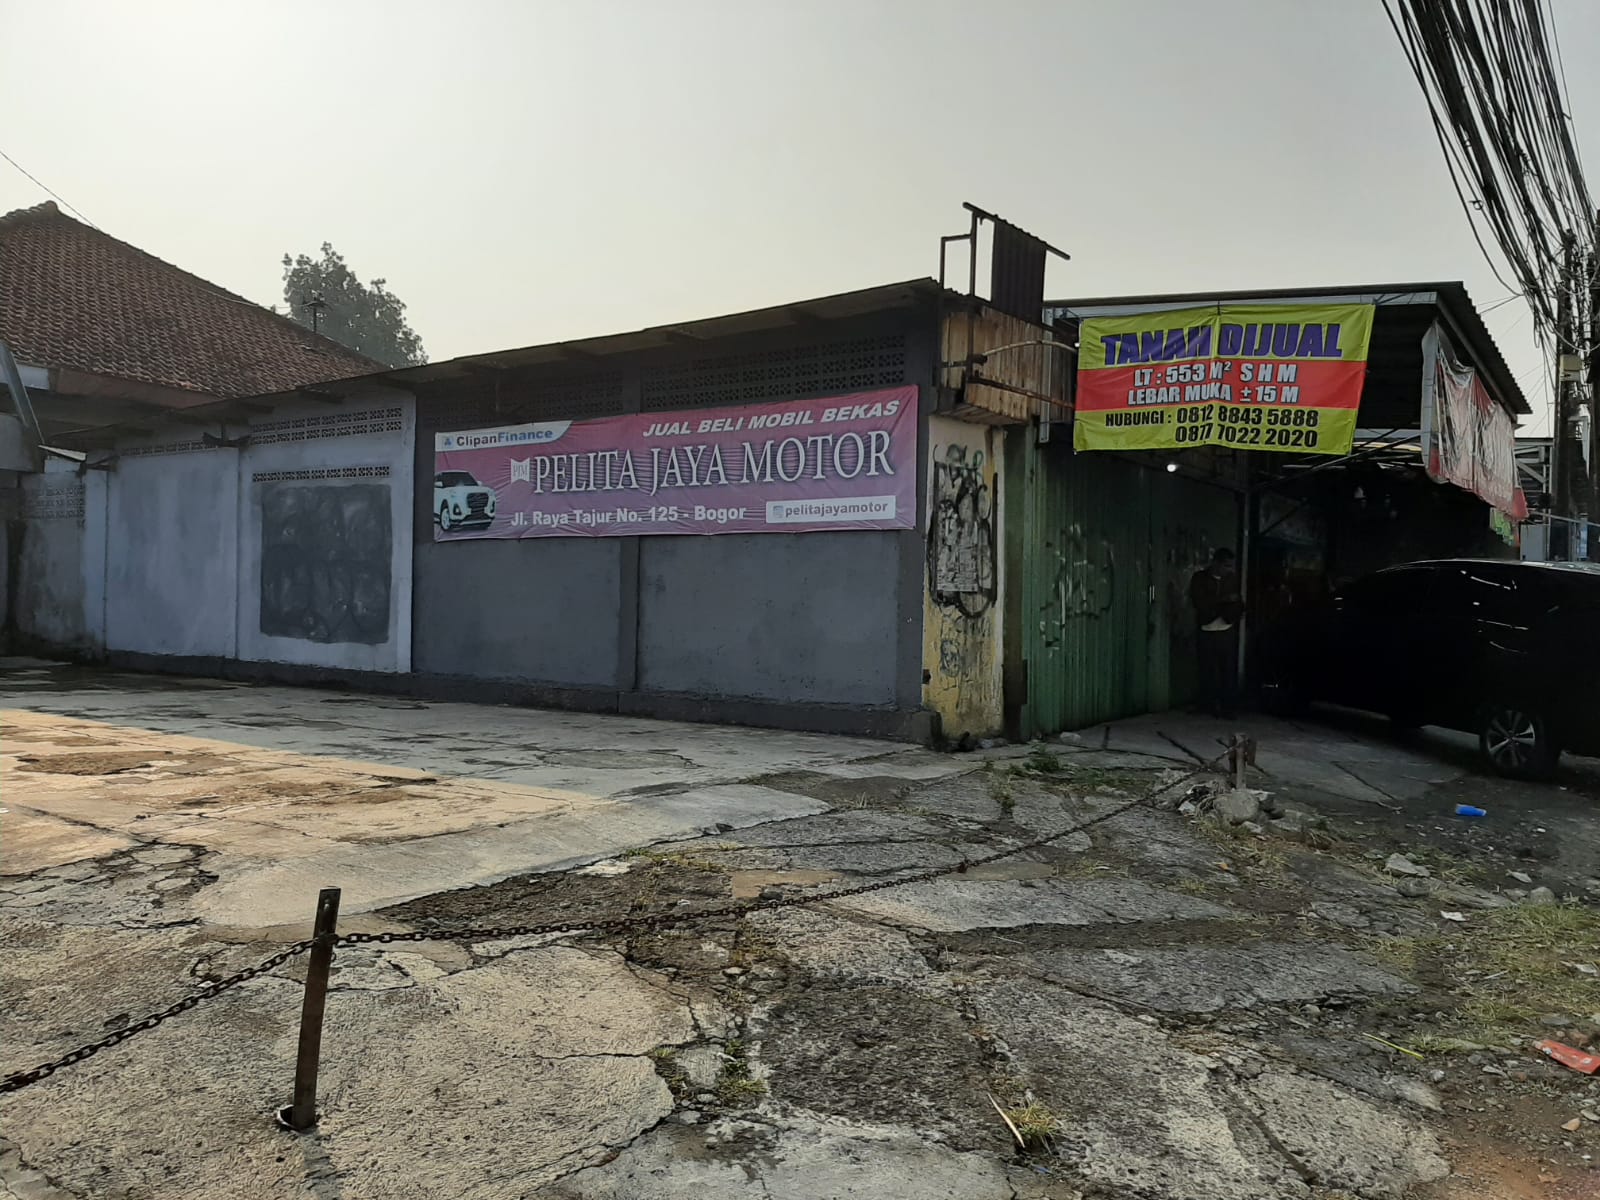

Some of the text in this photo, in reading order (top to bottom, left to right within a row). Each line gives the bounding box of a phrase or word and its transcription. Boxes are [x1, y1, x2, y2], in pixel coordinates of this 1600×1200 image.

[1100, 323, 1343, 366] TANAH DIJUAL
[1165, 363, 1205, 385] 553
[1127, 386, 1181, 406] LEBAR
[1184, 382, 1232, 404] MUKA
[642, 400, 900, 438] JUAL BELI MOBIL BEKAS
[1176, 403, 1214, 425] 0812
[1217, 406, 1264, 426] 8843
[1266, 408, 1319, 428] 5888
[1175, 423, 1318, 448] 0877 7022 2020
[533, 430, 895, 497] PELITA JAYA MOTOR
[532, 511, 569, 528] Raya
[572, 508, 613, 528] Tajur
[616, 507, 642, 524] No.
[649, 507, 679, 523] 125
[694, 505, 747, 524] Bogor
[785, 502, 889, 518] pelitajayamotor
